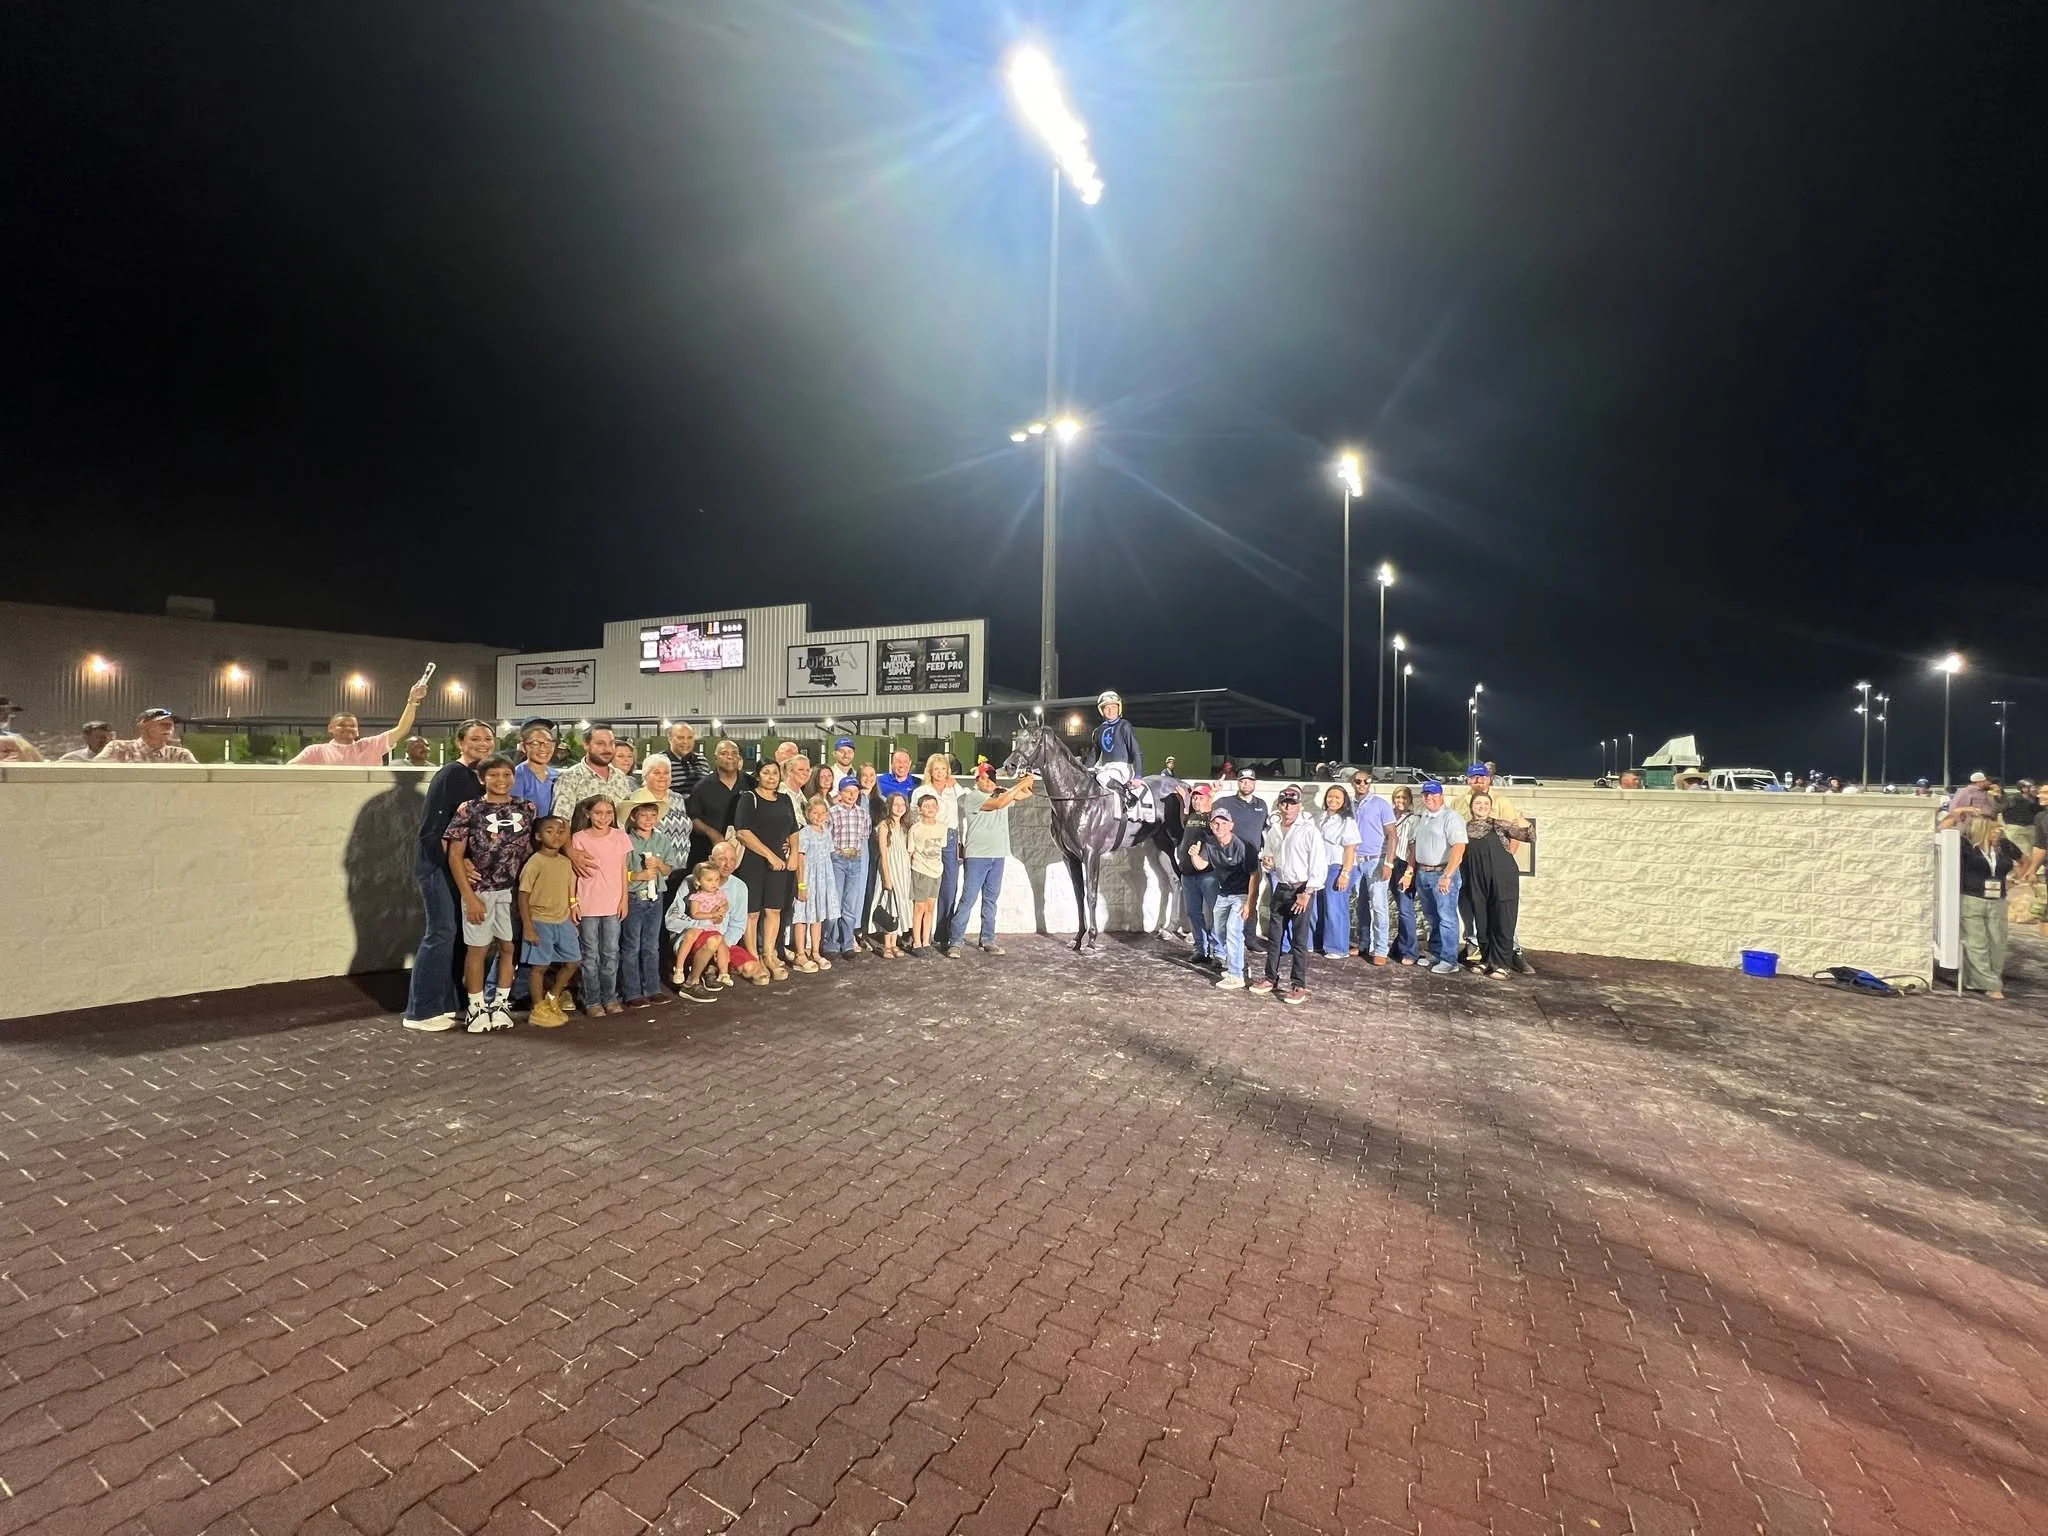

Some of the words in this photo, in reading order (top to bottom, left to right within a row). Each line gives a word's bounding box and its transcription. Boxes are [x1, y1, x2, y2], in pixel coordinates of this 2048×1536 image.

[930, 651, 957, 661] TATE'S
[926, 661, 946, 672] FEED
[947, 660, 964, 671] PRO
